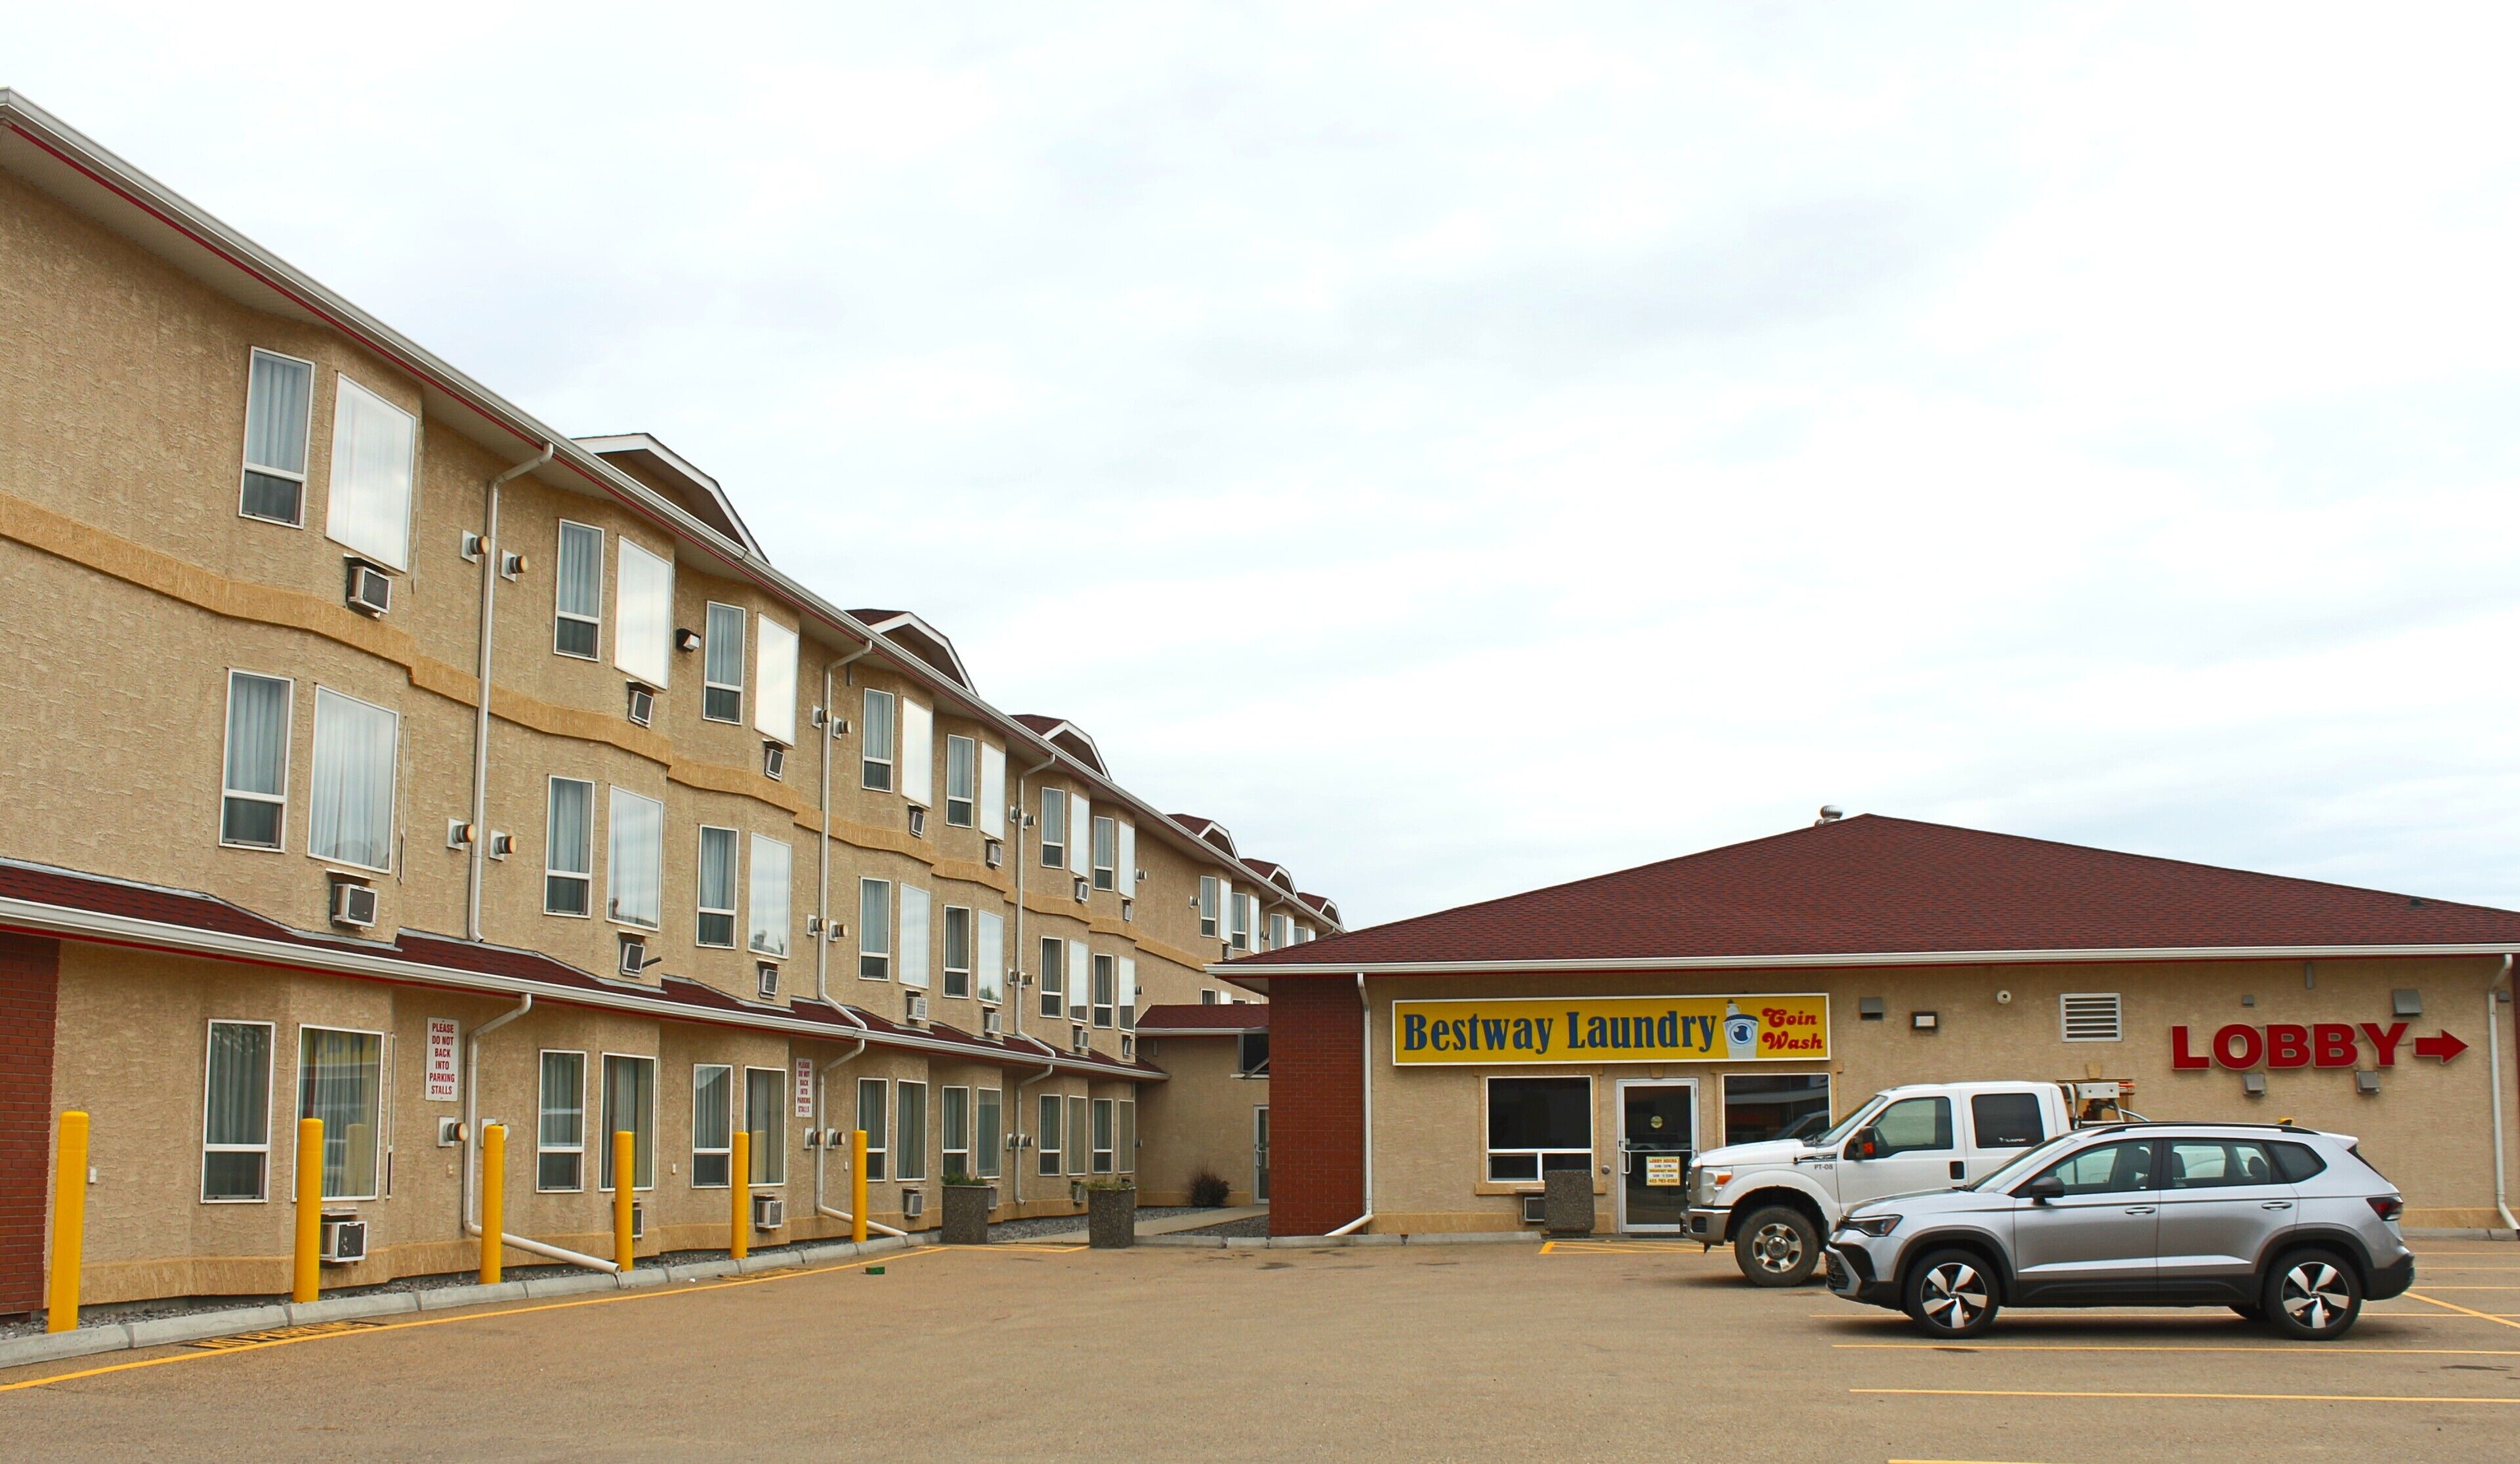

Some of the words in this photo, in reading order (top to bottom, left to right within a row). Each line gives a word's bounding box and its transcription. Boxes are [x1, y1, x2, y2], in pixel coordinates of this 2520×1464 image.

[1762, 1008, 1817, 1028] Coin
[432, 1022, 453, 1034] PLEASE
[1403, 1013, 1553, 1055] Bestway
[1566, 1011, 1717, 1052] Laundry
[432, 1035, 440, 1045] DO
[442, 1036, 454, 1045] NOT
[1762, 1031, 1823, 1050] Wash
[2171, 1022, 2409, 1069] LOBBY
[434, 1048, 451, 1057] BACK
[435, 1060, 450, 1070] INTO
[429, 1073, 455, 1082] PARKING
[430, 1085, 452, 1095] STALLS
